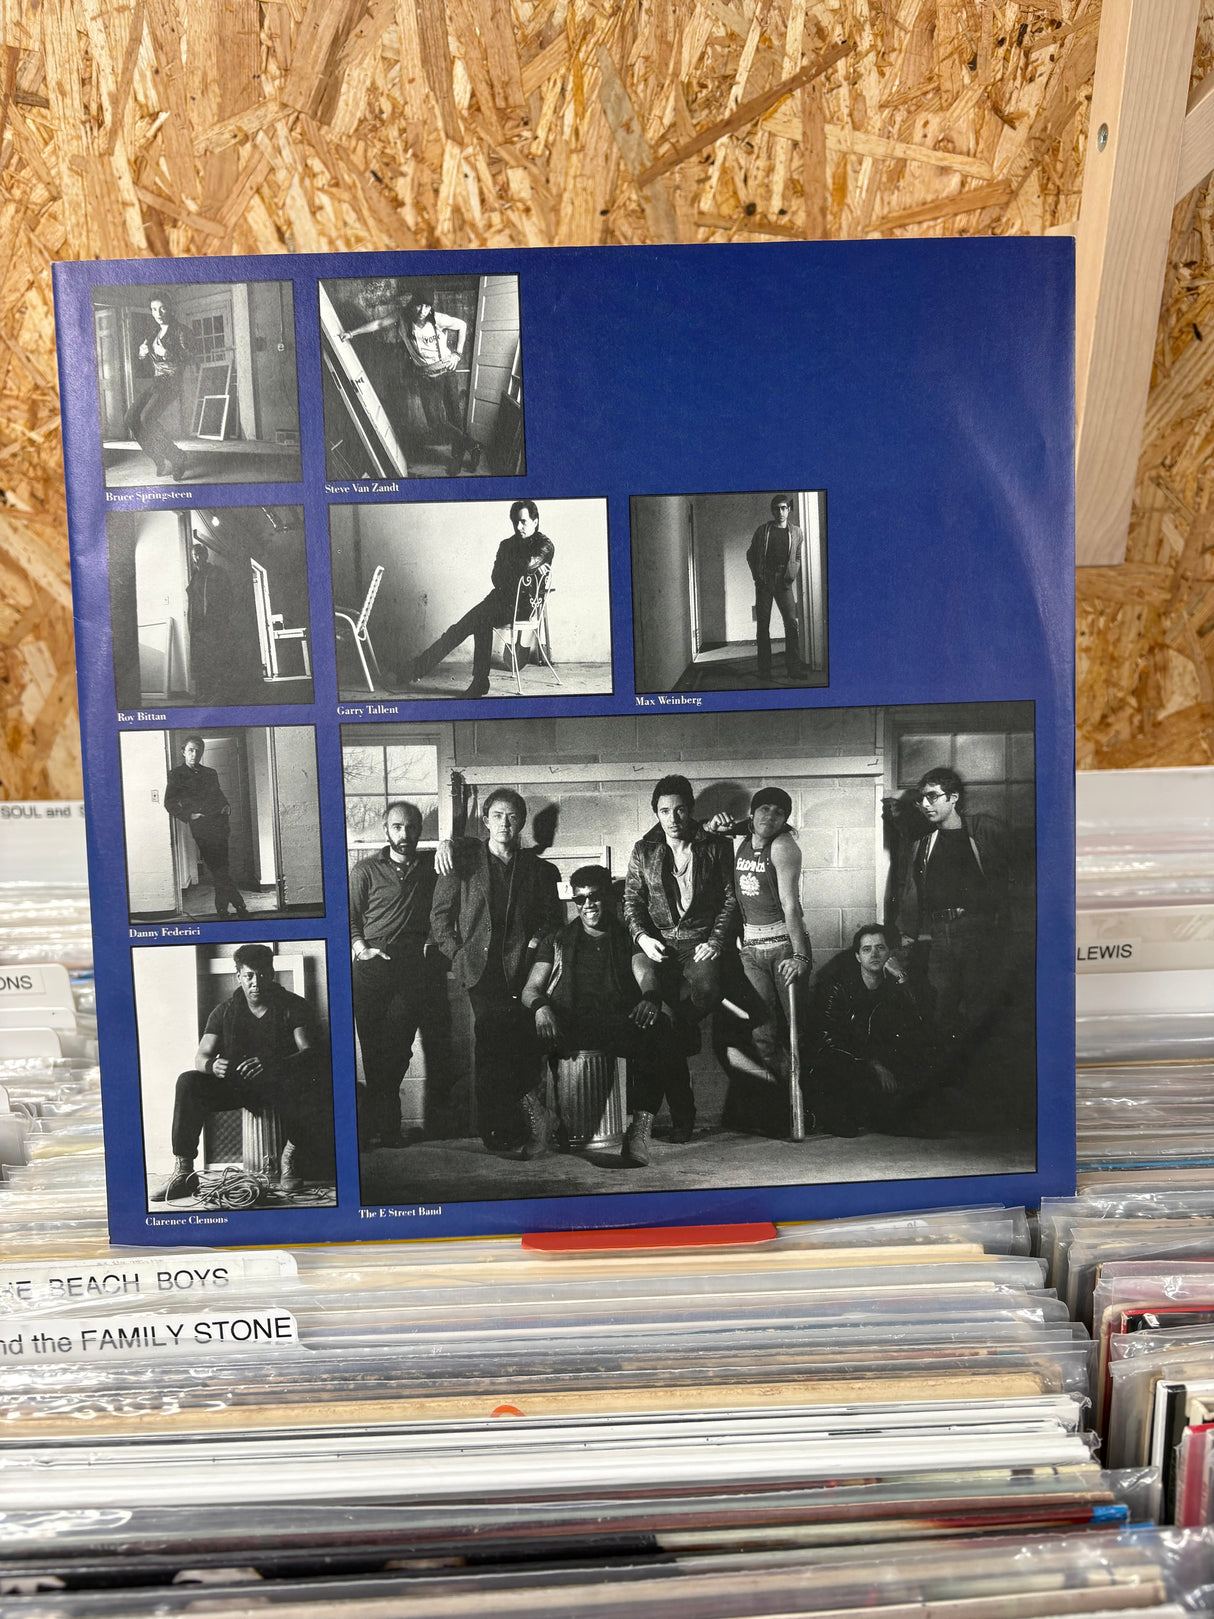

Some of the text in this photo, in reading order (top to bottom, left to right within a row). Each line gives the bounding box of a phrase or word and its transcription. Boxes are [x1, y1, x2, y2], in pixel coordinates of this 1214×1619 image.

[325, 482, 399, 494] Steve Van Zandt
[105, 491, 193, 503] Bruce Springsteen
[635, 695, 702, 707] Max Weinberg
[117, 711, 167, 725] Roy Bittan
[336, 704, 399, 718] Garry Tallent
[1, 805, 42, 819] SOUL
[46, 805, 71, 819] and
[128, 926, 201, 940] Danny Federici
[1077, 943, 1133, 961] LEWIS
[358, 1204, 442, 1219] The E Street Band
[145, 1215, 229, 1226] Clarence Clemons
[48, 1273, 140, 1298] BEACH
[156, 1267, 230, 1292] BOYS
[30, 1332, 73, 1354] the
[80, 1323, 184, 1352] FAMILY
[193, 1316, 293, 1345] STONE
